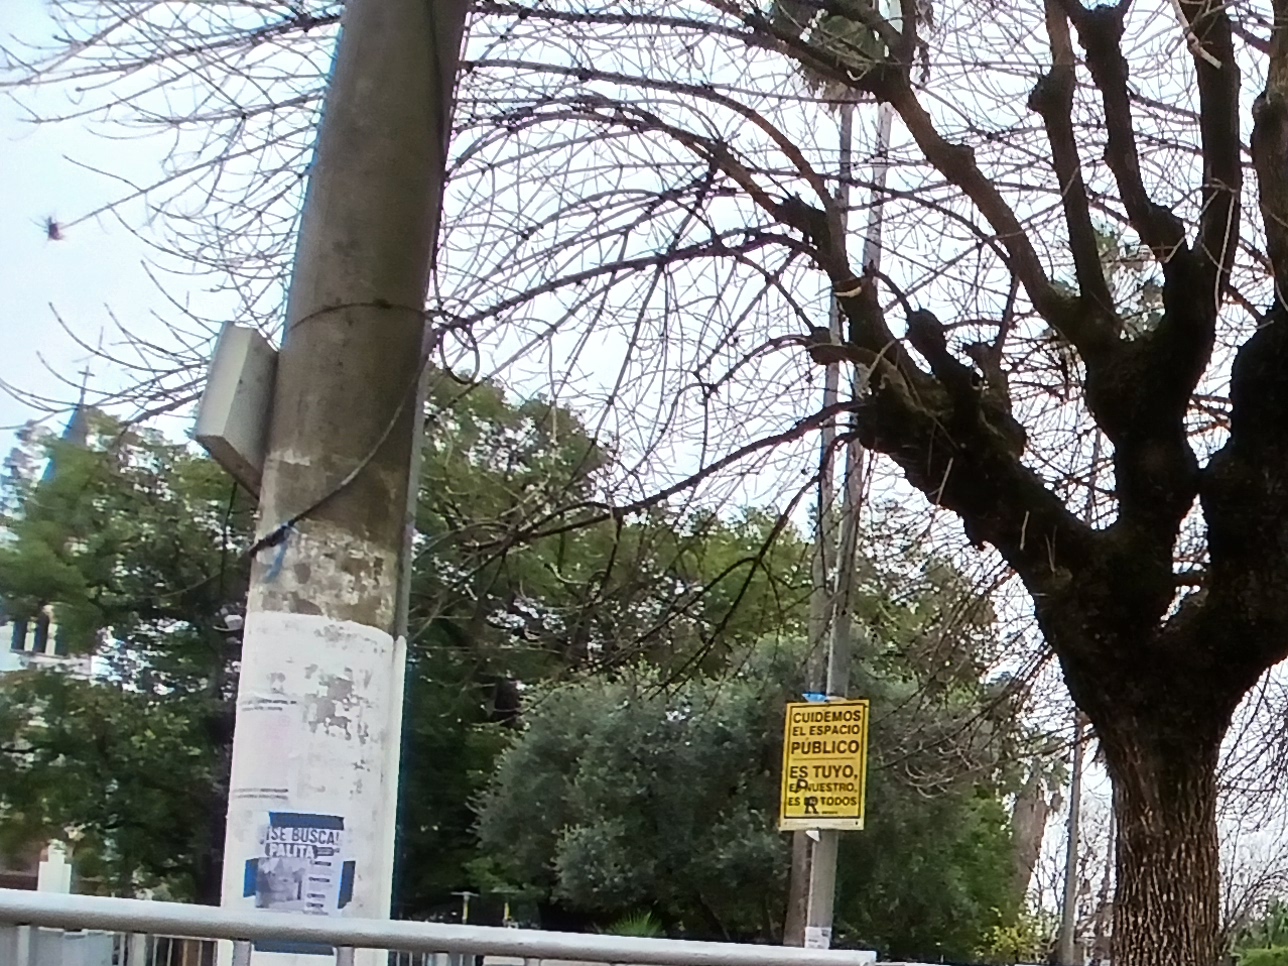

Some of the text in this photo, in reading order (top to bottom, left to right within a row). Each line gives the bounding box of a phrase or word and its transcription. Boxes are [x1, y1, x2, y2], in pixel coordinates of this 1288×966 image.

[793, 710, 861, 723] CUIDEMOS
[792, 724, 860, 736] EL ESPACIO
[789, 764, 858, 780] ES TUYO,
[788, 797, 800, 806] ES
[820, 796, 857, 806] TODOS
[269, 843, 316, 858] PALITA
